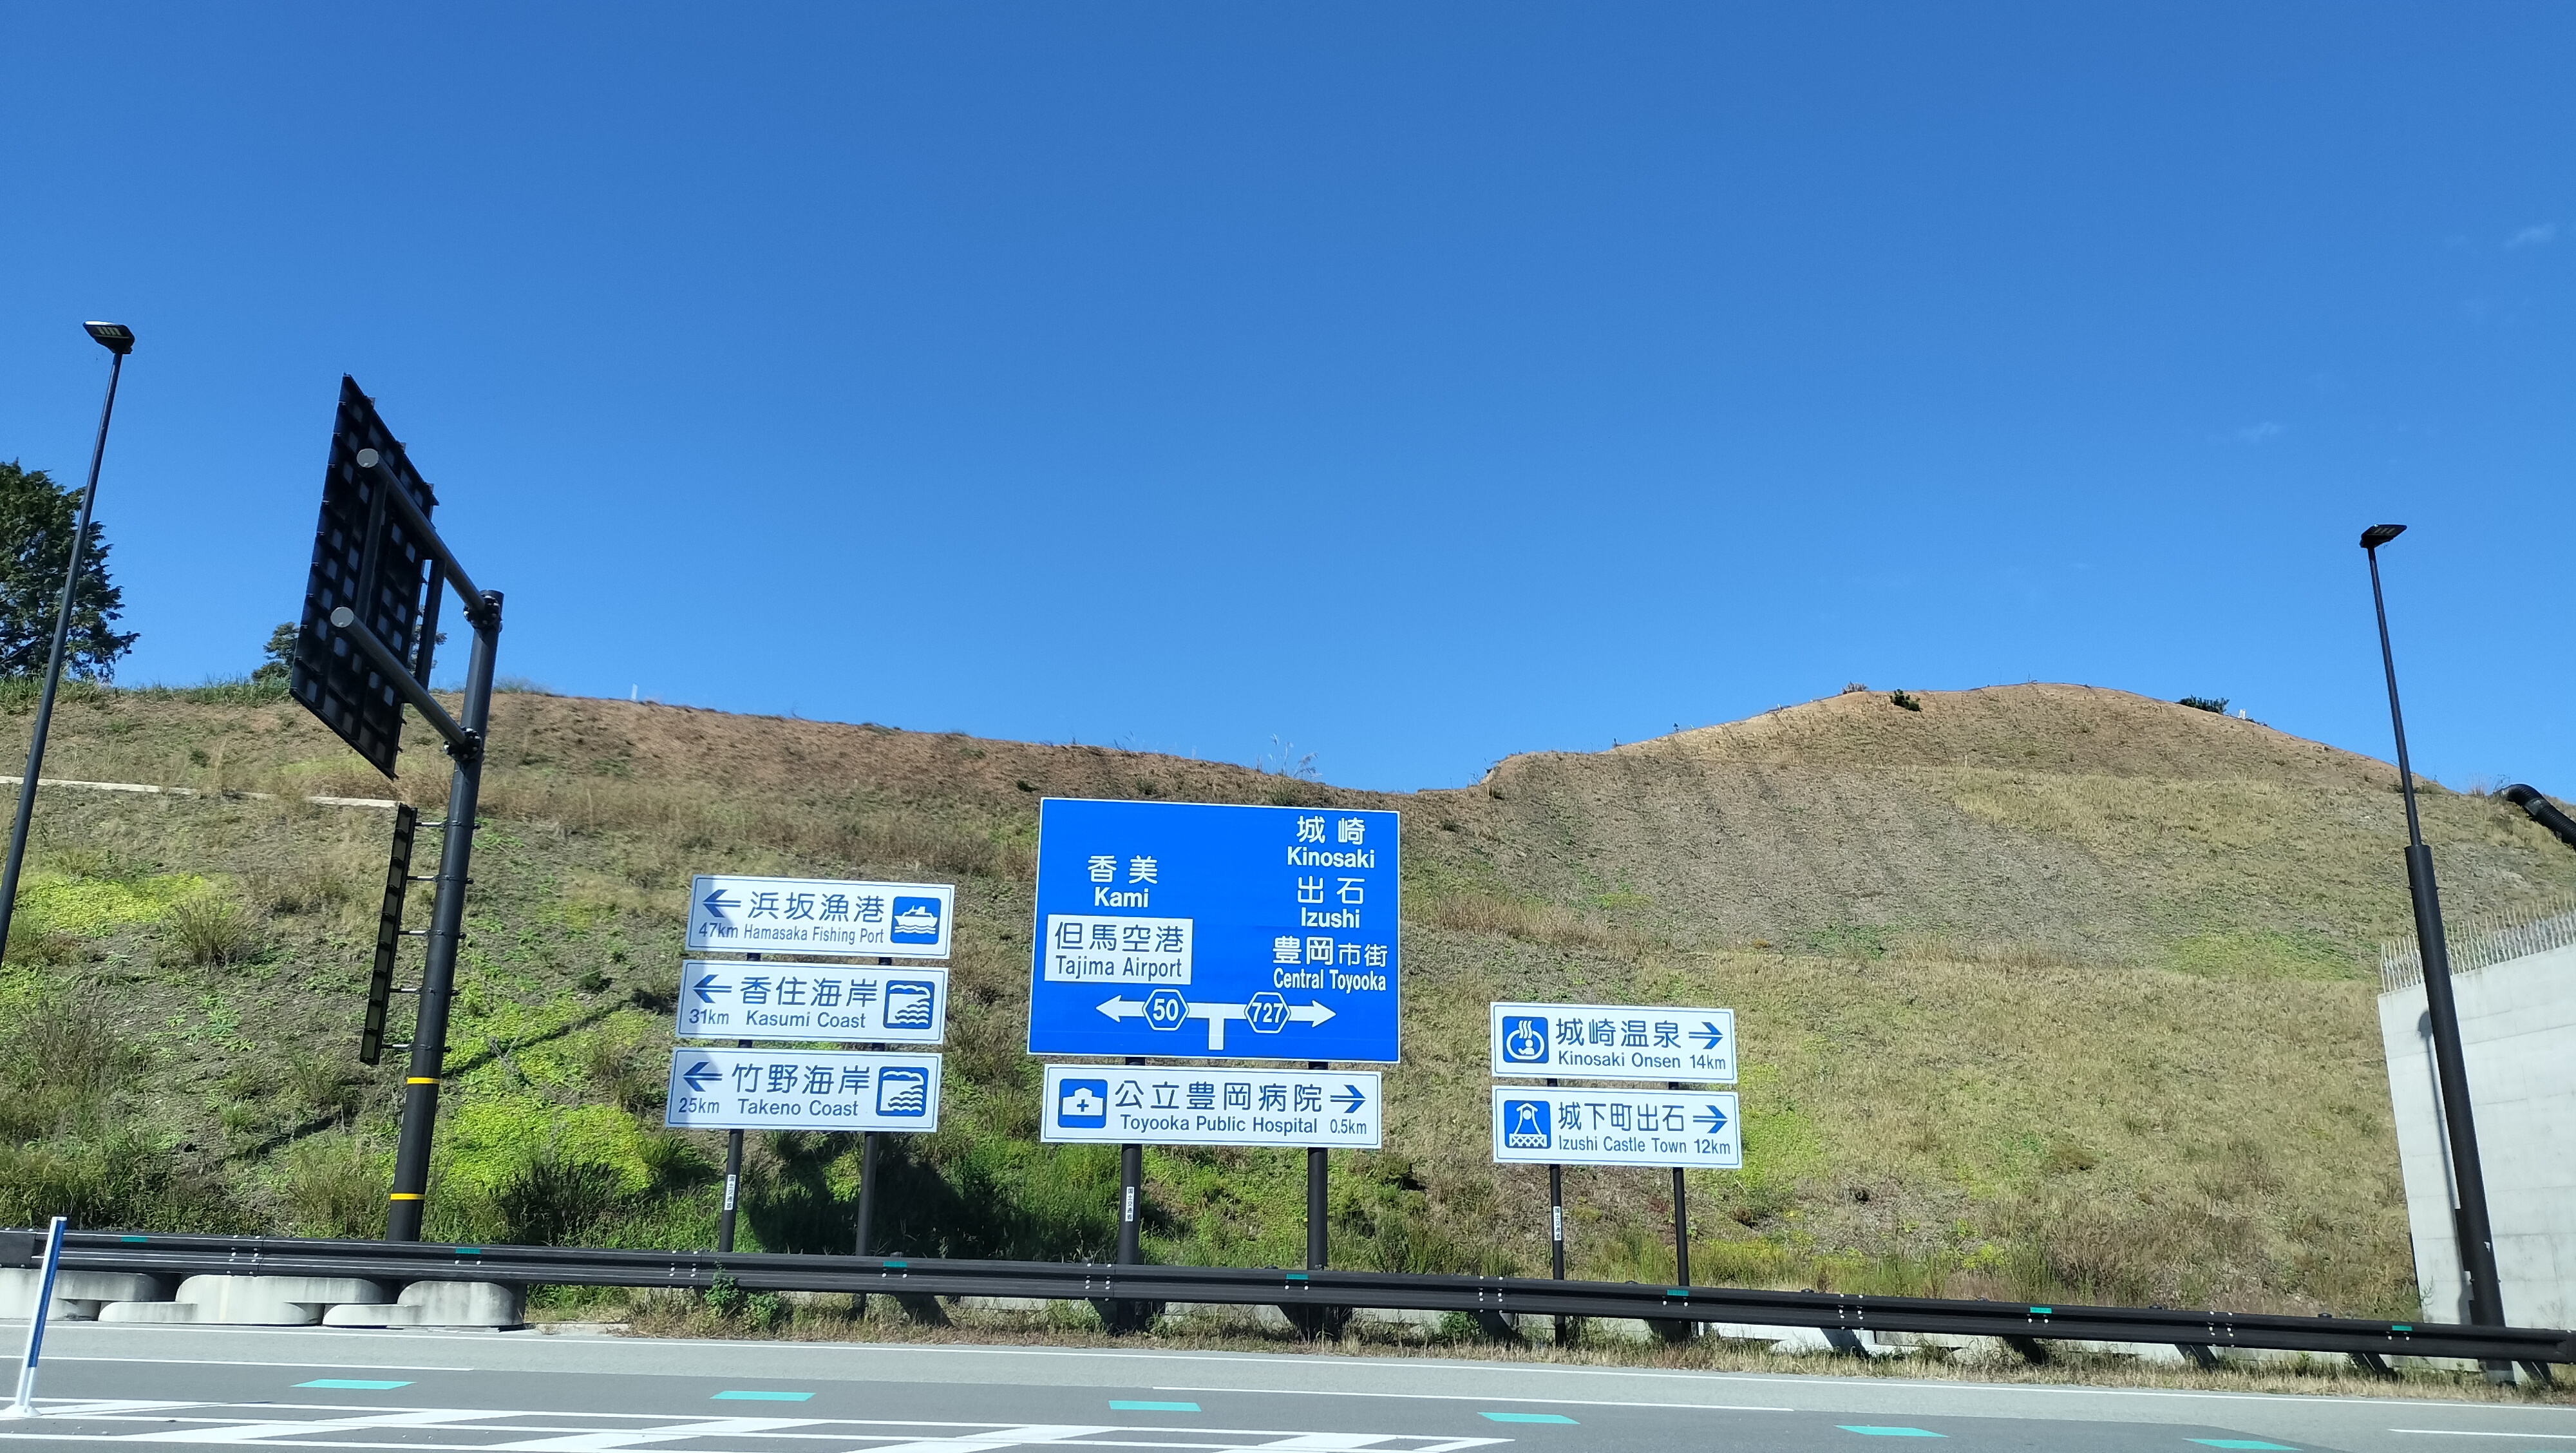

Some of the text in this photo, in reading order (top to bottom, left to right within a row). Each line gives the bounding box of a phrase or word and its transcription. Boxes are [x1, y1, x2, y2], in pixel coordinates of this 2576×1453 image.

[1296, 815, 1366, 845] 城崎
[1086, 855, 1158, 884] 香美
[1287, 846, 1375, 868] Kinosaki
[1094, 887, 1149, 907] Kami
[1297, 876, 1365, 905] 出石
[747, 891, 885, 923] 浜坂漁港
[1301, 907, 1360, 929] Izushi
[698, 923, 884, 945] 47km Hamasaka Fishing Port
[1054, 922, 1184, 953] 但馬空港
[1273, 936, 1388, 967] 豊岡市街
[1056, 955, 1182, 981] Tajima Airport
[1273, 969, 1387, 993] Central Toyooka
[739, 976, 878, 1007] 香住海岸
[688, 1009, 866, 1029] 31km Kasumi Coast
[1153, 998, 1179, 1021] 50
[1252, 1002, 1282, 1023] 727
[1555, 1018, 1681, 1049] 城崎温泉
[1558, 1050, 1727, 1070] Kinosaki Onsen 14km
[732, 1063, 871, 1096] 竹野海岸
[678, 1097, 858, 1117] 25km Takeno Coast
[1115, 1080, 1322, 1112] 公立豊岡病院
[1120, 1114, 1367, 1135] Toyooka Public Hospital 0.5km
[1558, 1101, 1685, 1132] 城下町出石
[1558, 1135, 1731, 1155] Izushi Castle Town 12km
[726, 1175, 735, 1209] 国土交通省
